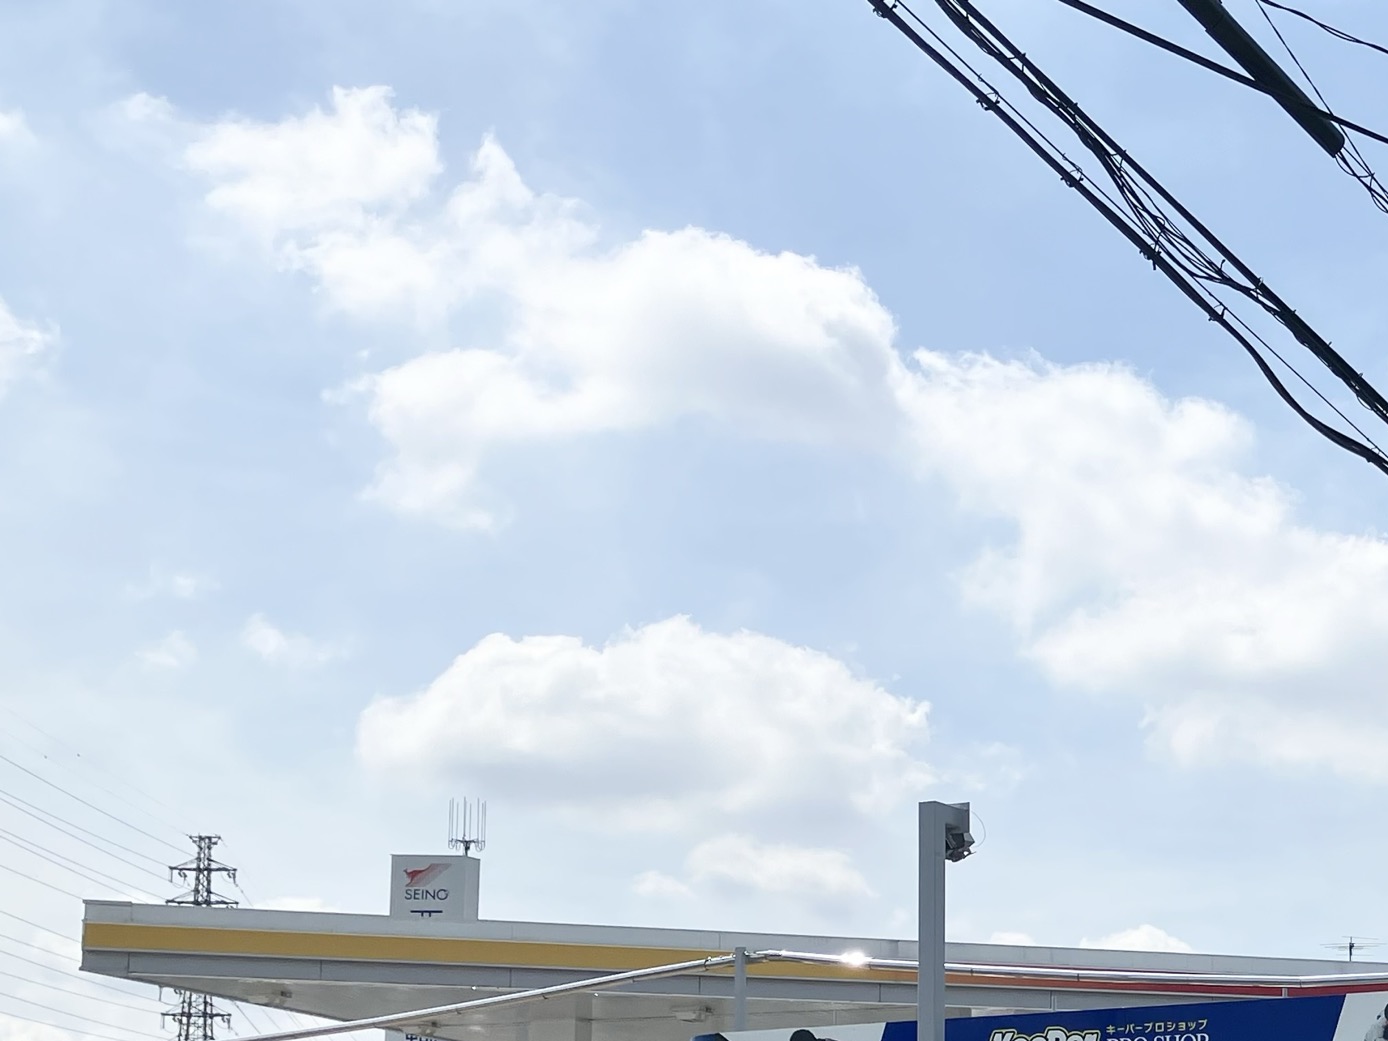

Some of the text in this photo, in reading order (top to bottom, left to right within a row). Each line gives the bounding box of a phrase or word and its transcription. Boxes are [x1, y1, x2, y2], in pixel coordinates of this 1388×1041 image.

[405, 888, 449, 901] SEINO
[1106, 1019, 1208, 1035] キーパープロショップ
